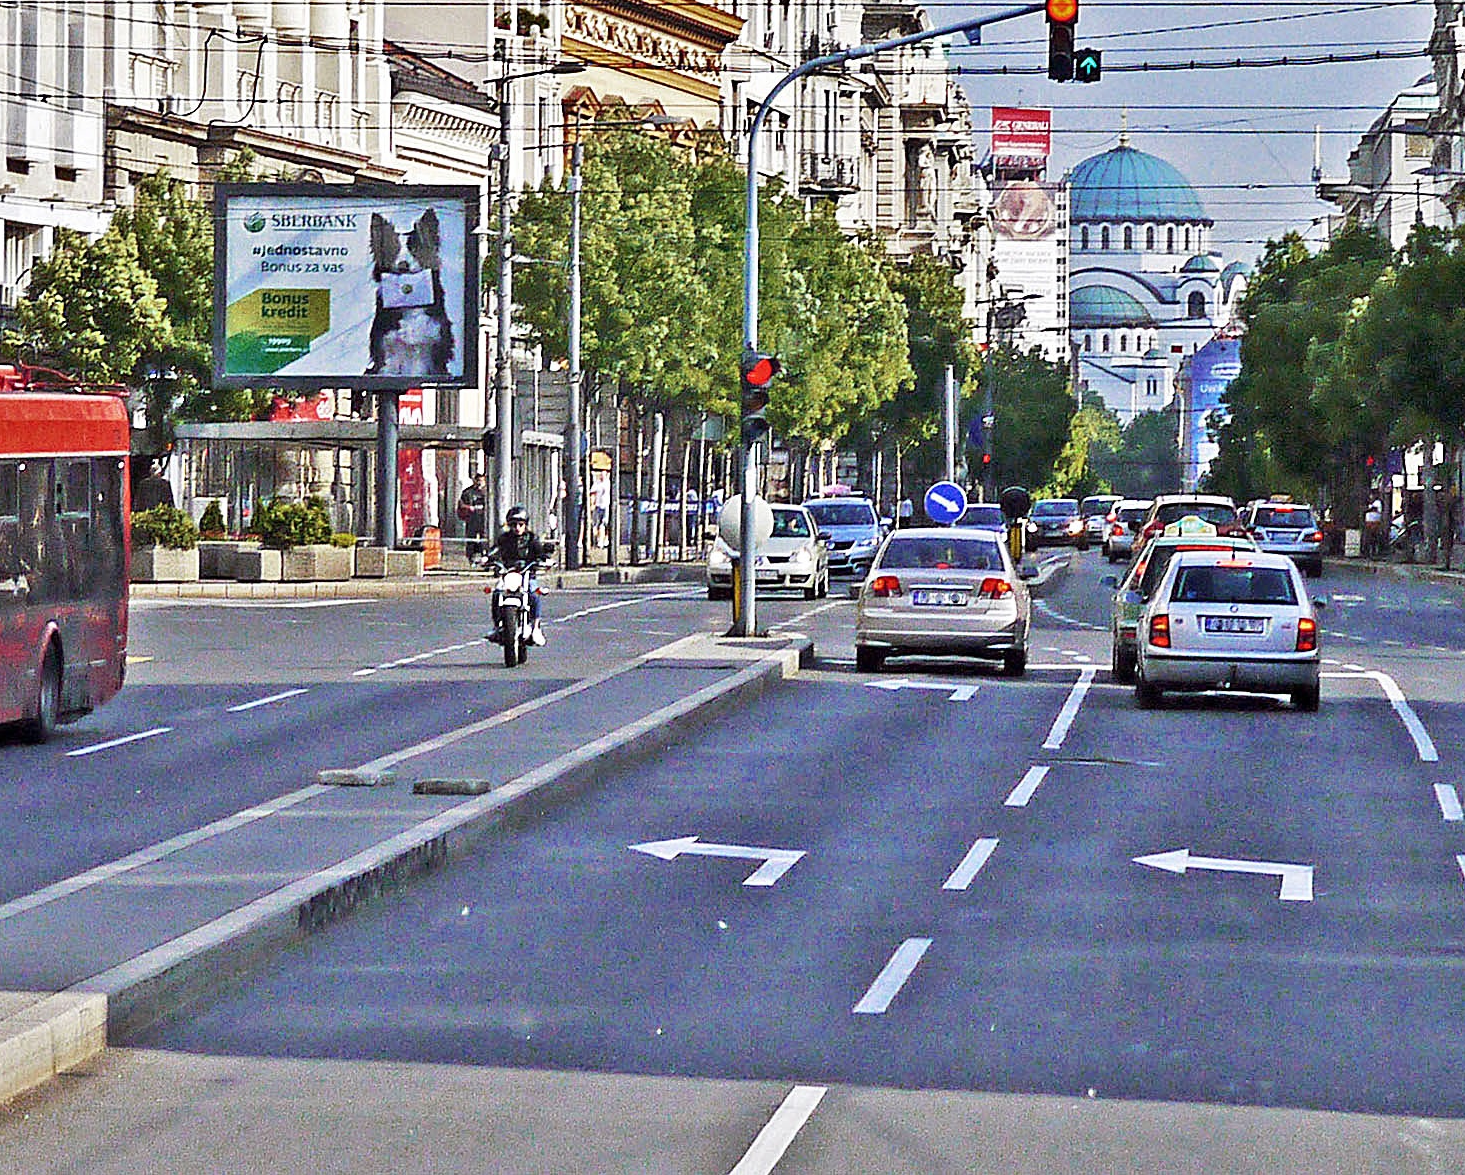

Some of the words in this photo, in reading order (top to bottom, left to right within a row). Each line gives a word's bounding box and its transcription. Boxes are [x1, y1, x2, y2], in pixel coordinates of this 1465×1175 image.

[272, 214, 357, 228] SBERBANK
[261, 261, 302, 273] Bonus
[305, 263, 320, 273] za
[323, 263, 345, 273] vas
[262, 292, 309, 304] Bonus
[262, 305, 308, 318] kredit
